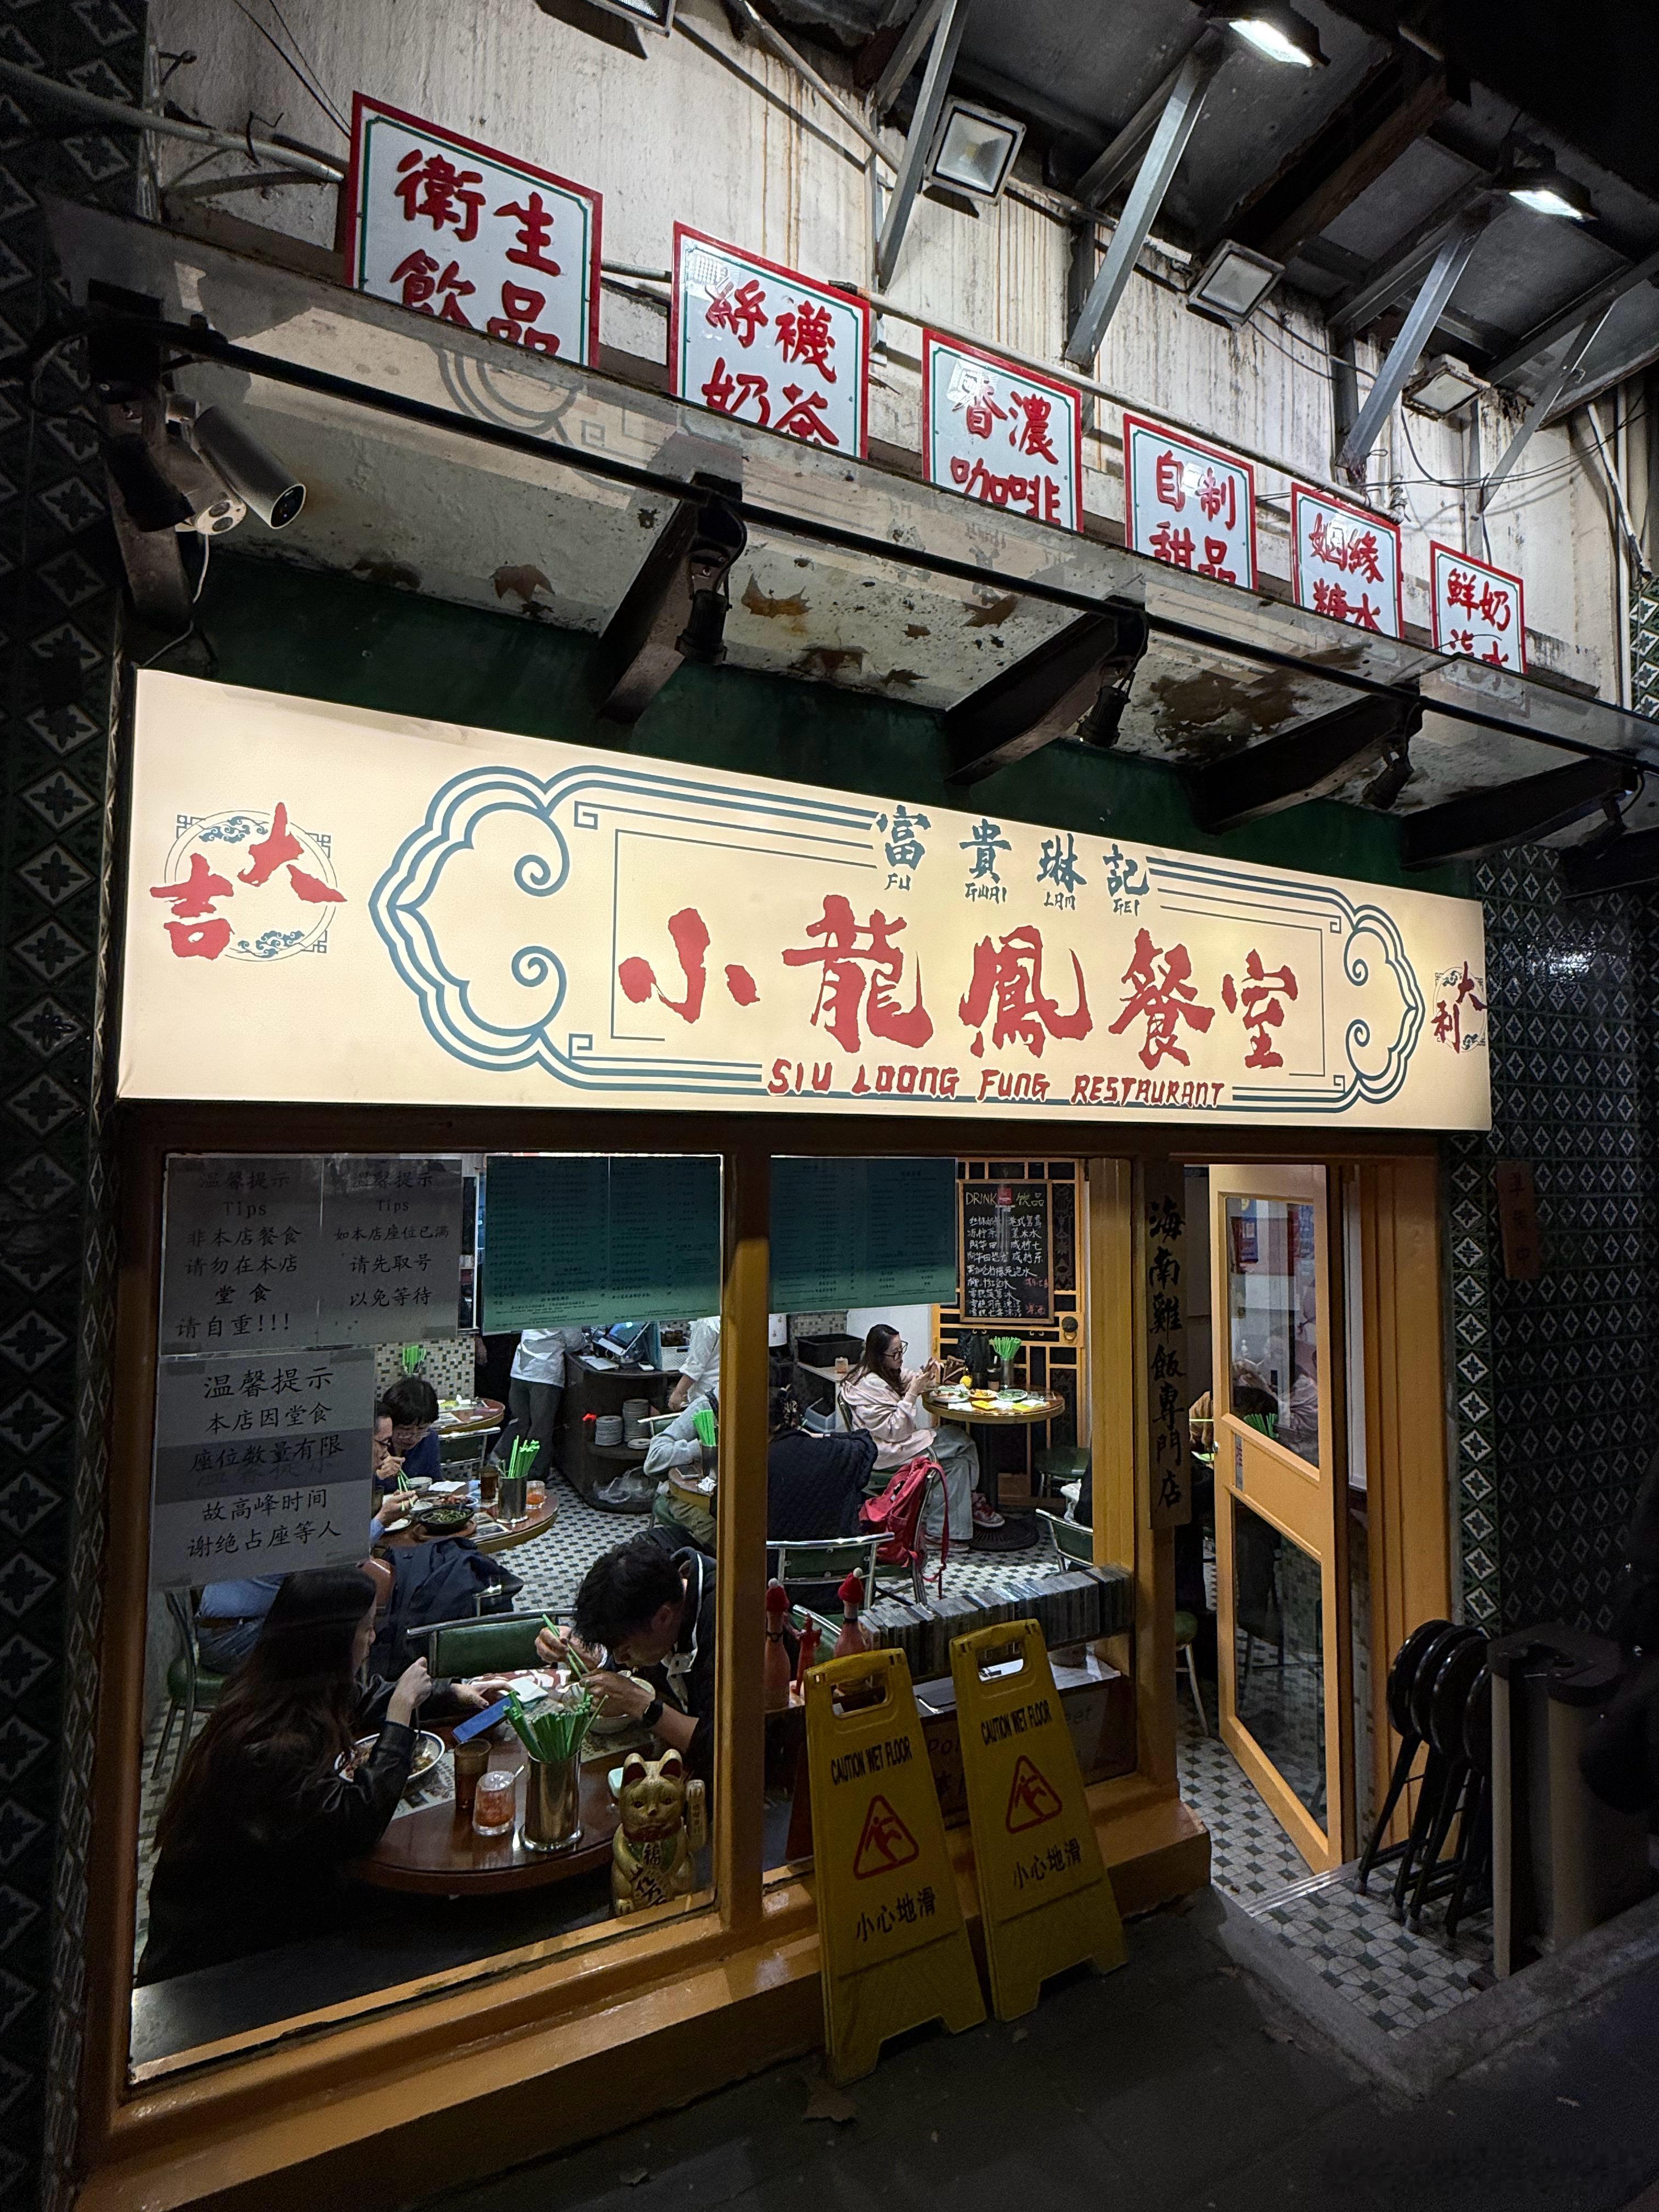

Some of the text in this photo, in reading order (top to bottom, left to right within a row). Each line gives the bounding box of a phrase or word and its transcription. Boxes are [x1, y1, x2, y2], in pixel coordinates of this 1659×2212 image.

[951, 456, 1062, 527] 咖啡
[1447, 568, 1511, 631] 鮮奶
[884, 872, 1140, 916] FU GWAI LAM GEI
[768, 1058, 1224, 1108] SIU LOONG FUNG RESTAURANT
[223, 1201, 267, 1217] Tips
[376, 1199, 410, 1214] Tips
[188, 1225, 302, 1247] 非本店餐食
[333, 1224, 450, 1243] 如本店座位已满
[184, 1254, 298, 1277] 请勿在本店
[349, 1252, 432, 1274] 请先取号
[349, 1286, 432, 1308] 以免等待
[1148, 1194, 1186, 1509] 海南雞飯專門店
[202, 1367, 334, 1400] 温馨提示
[205, 1402, 333, 1435] 本店因堂食
[189, 1434, 345, 1472] 座位数量有限
[201, 1488, 328, 1522] 故高峰时间
[187, 1520, 342, 1559] 谢绝占座等人
[981, 1713, 1013, 1746] CAUTION
[1010, 1707, 1029, 1734] WET
[1027, 1700, 1053, 1728] FLOOR
[831, 1750, 866, 1786] CAUTION
[865, 1744, 884, 1774] WET
[885, 1736, 913, 1768] FLOOR
[1013, 1837, 1083, 1890] 小心地滑
[855, 1886, 937, 1943] 小心地滑
